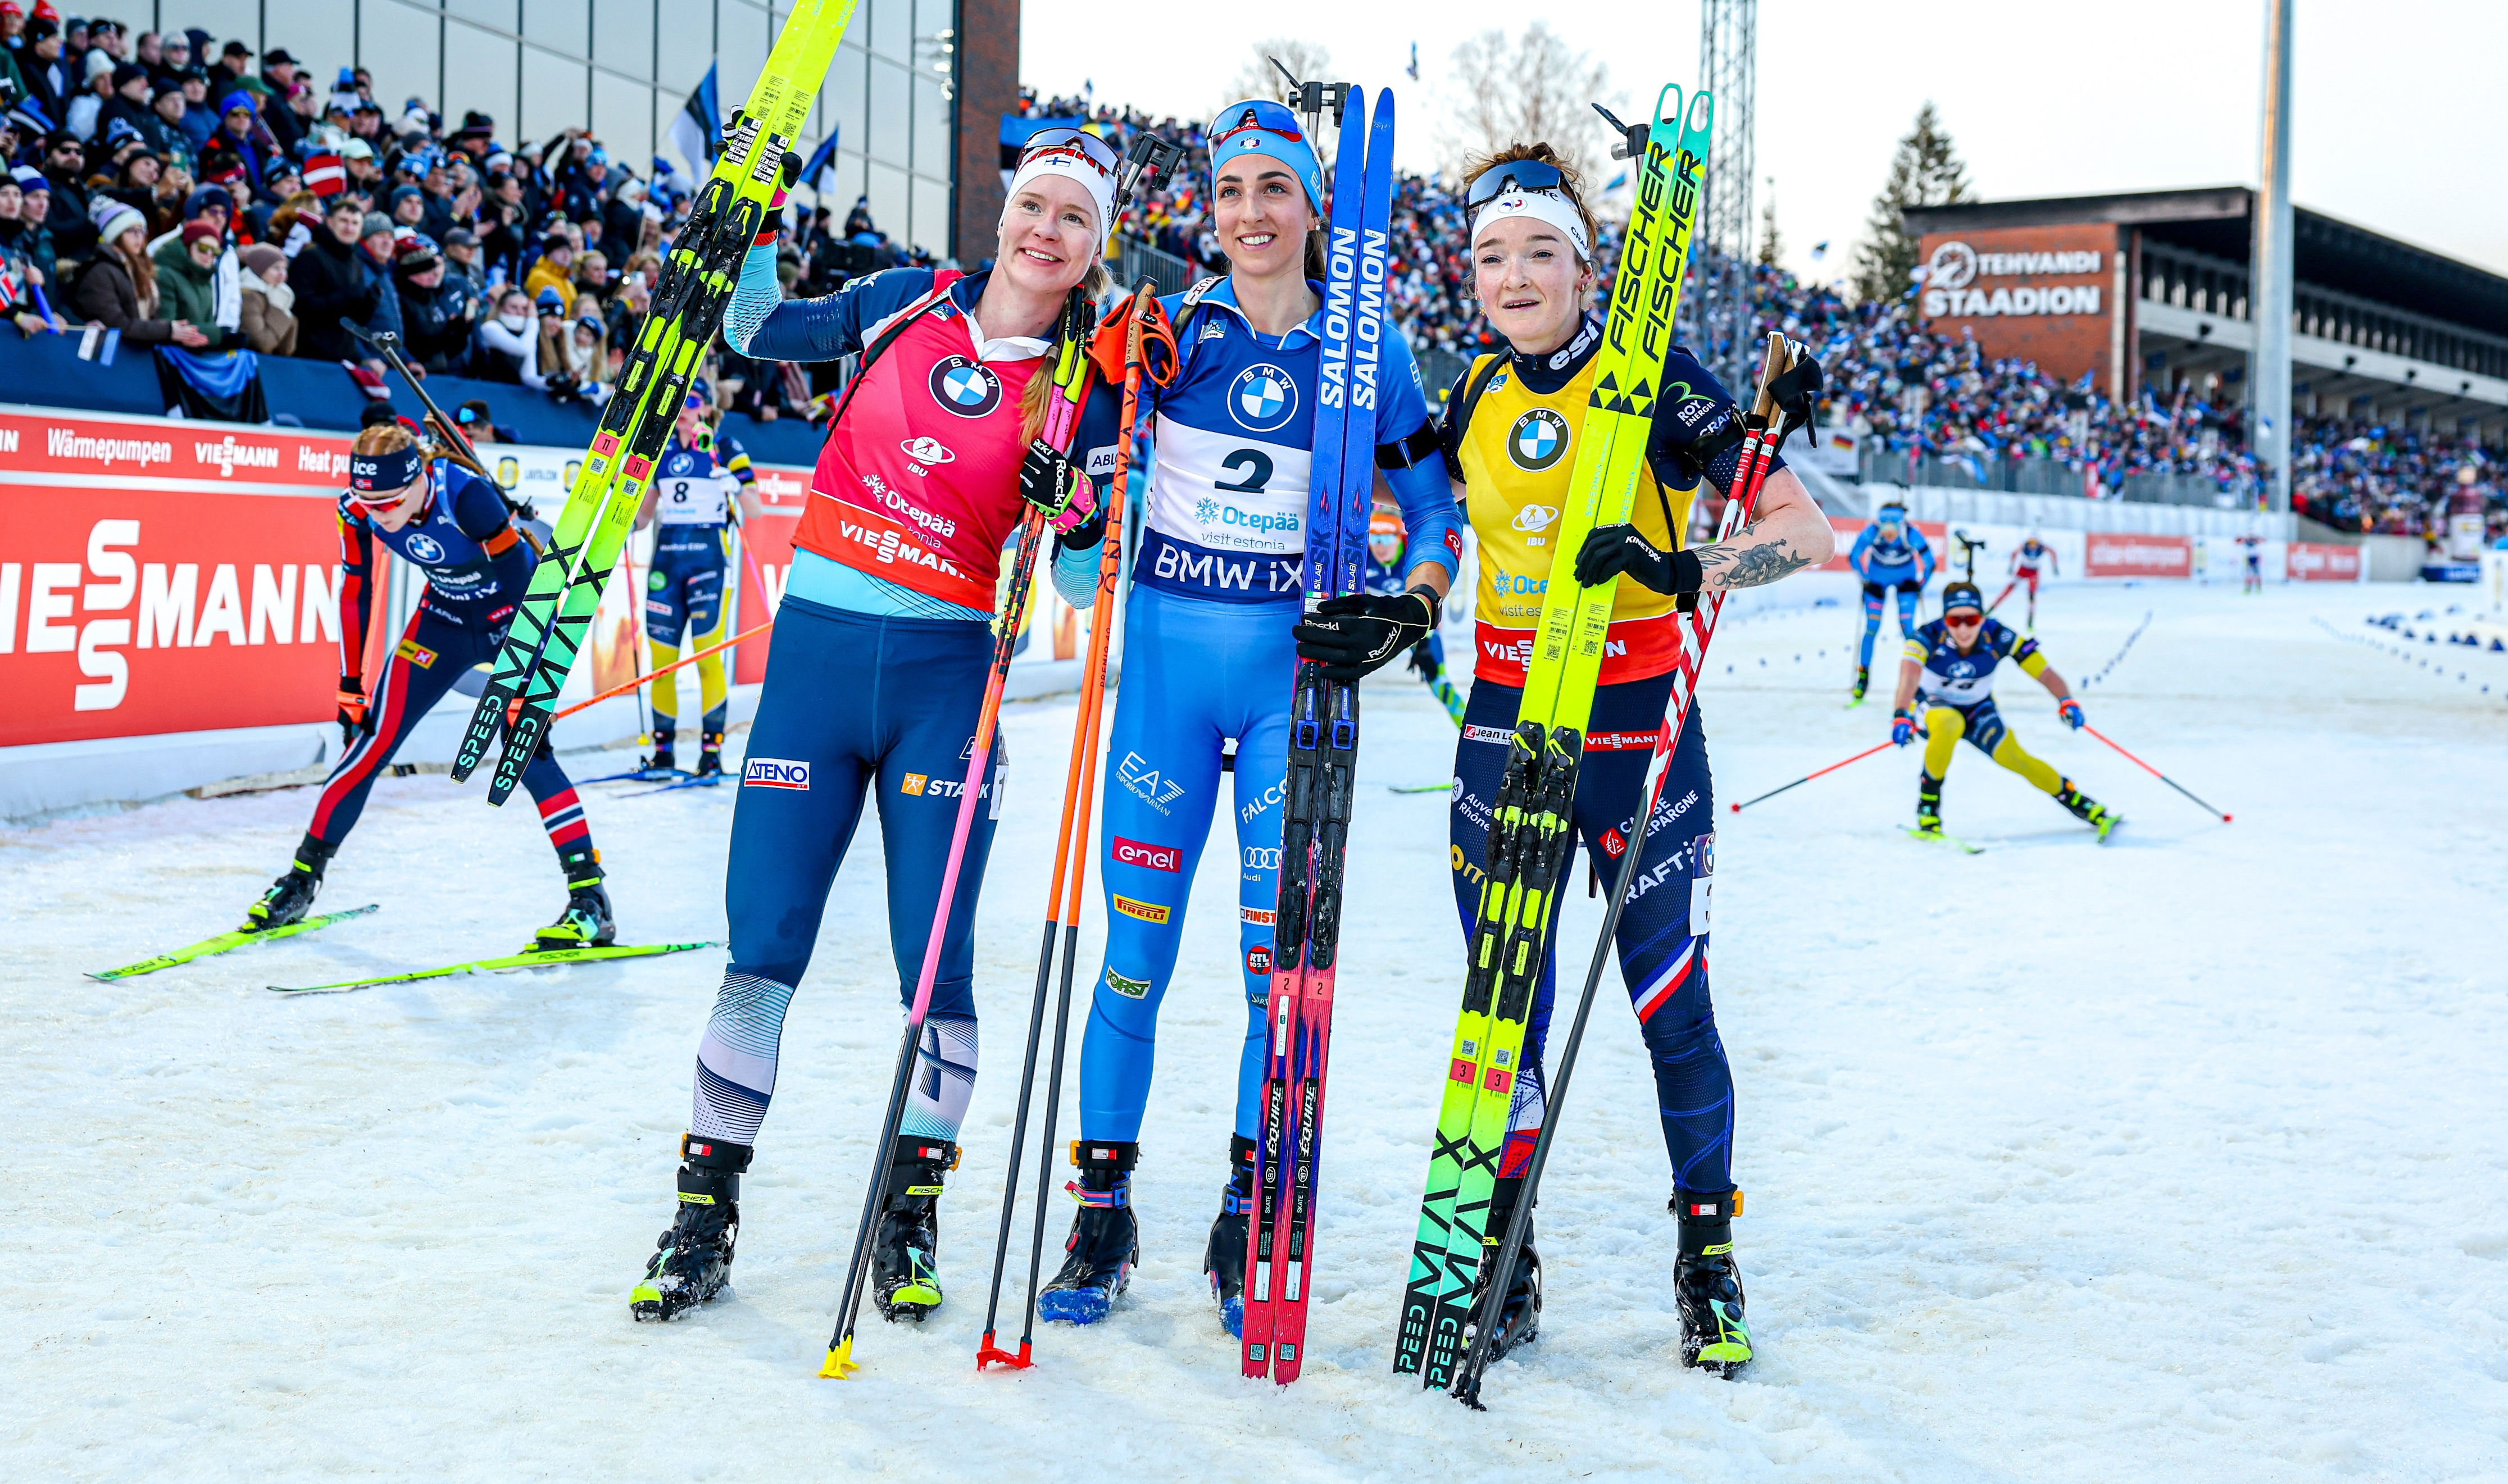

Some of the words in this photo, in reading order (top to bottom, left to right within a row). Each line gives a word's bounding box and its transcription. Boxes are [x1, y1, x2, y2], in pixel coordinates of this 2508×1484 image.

[812, 0, 824, 16] SPE
[1571, 227, 1589, 252] CRAF
[1609, 142, 1670, 356] FISCHER
[1642, 148, 1701, 362] FISCHER
[1978, 251, 2102, 276] TEHVANDI
[1924, 285, 2100, 317] STAADION
[1320, 226, 1356, 409] SALOMON
[1352, 228, 1388, 411] SALOMON
[950, 358, 998, 389] BMW
[1243, 367, 1291, 390] BMW
[1519, 411, 1562, 429] BMW
[1677, 399, 1701, 422] ROY
[1685, 401, 1715, 427] ENERGIE
[47, 428, 172, 467] Wärmepumpen
[194, 435, 279, 477] VIESSMANN
[602, 438, 611, 451] 11
[297, 445, 330, 472] Heat
[353, 461, 378, 476] ice
[634, 461, 643, 474] 11
[907, 463, 928, 477] IBU
[1092, 453, 1118, 467] ABL
[1215, 448, 1274, 494] 2
[674, 481, 689, 503] 8
[885, 490, 956, 539] Otepää
[1223, 507, 1300, 534] Otepää
[1201, 531, 1232, 545] visit
[1234, 534, 1285, 550] estonia
[1526, 536, 1546, 546] IBU
[1155, 543, 1252, 591] BMW
[1513, 575, 1548, 595] Ote
[1498, 603, 1522, 617] visit
[1484, 639, 1628, 672] VIESSN
[458, 695, 502, 769] SPEED
[1476, 728, 1501, 740] Jean
[496, 717, 538, 791] SPEED
[928, 779, 991, 799] STAK
[1115, 770, 1139, 796] EMPORIO
[1143, 793, 1172, 818] ARMANI
[1465, 792, 1493, 817] Auve
[1119, 845, 1175, 871] enel
[1243, 872, 1261, 882] Audi
[1624, 850, 1684, 905] RAFT
[1116, 898, 1166, 922] PIRELLI
[1250, 952, 1270, 963] RTL
[1107, 967, 1151, 997] FORST
[1284, 977, 1290, 991] 2
[1317, 981, 1323, 995] 2
[1460, 1064, 1467, 1077] 3
[1494, 1073, 1501, 1086] 3
[1267, 1168, 1275, 1181] 187
[1300, 1168, 1308, 1181] 187
[677, 1194, 708, 1203] SCHER
[1399, 1304, 1426, 1376] PEED
